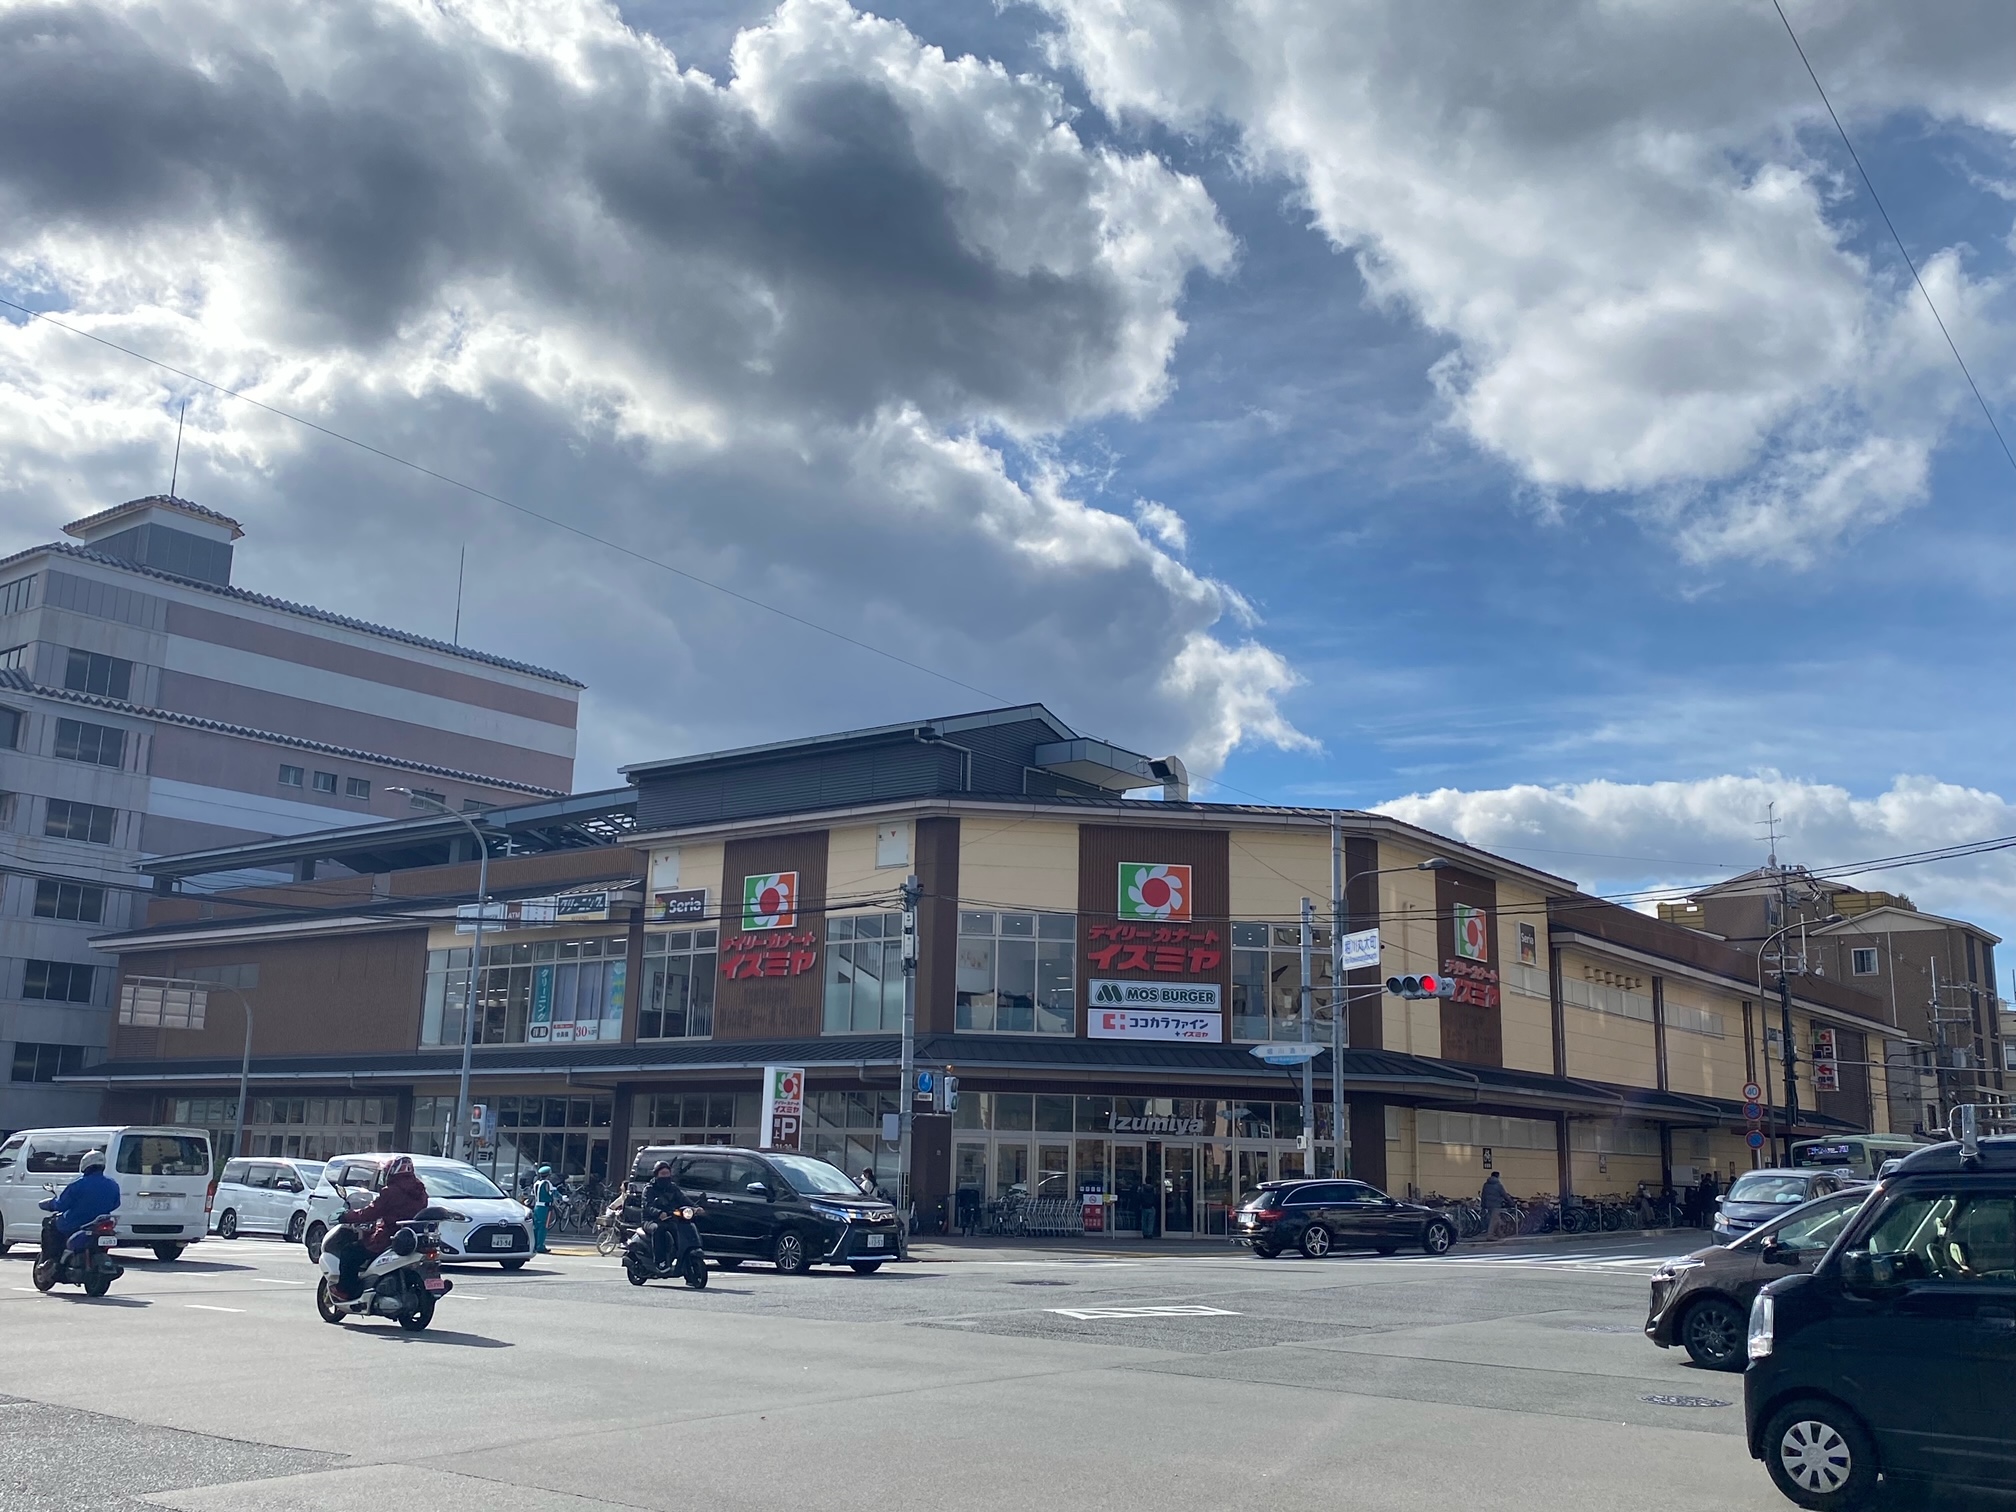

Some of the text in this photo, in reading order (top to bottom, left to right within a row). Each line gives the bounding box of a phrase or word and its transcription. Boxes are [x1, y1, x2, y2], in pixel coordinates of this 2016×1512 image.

[669, 898, 702, 913] Seria
[508, 911, 521, 920] ATM
[1088, 925, 1220, 944] デイリーカナート
[1520, 932, 1534, 945] Seria
[720, 950, 817, 979] イズミヤ
[1087, 944, 1221, 973] イズミヤ
[537, 968, 550, 1021] クリーニング
[1126, 988, 1215, 1003] MOS BURGER
[1129, 1016, 1209, 1030] ココカラファイン
[1747, 1087, 1757, 1096] 40
[774, 1105, 800, 1113] イズミヤ
[780, 1117, 797, 1141] P
[1108, 1111, 1204, 1135] Izumiya
